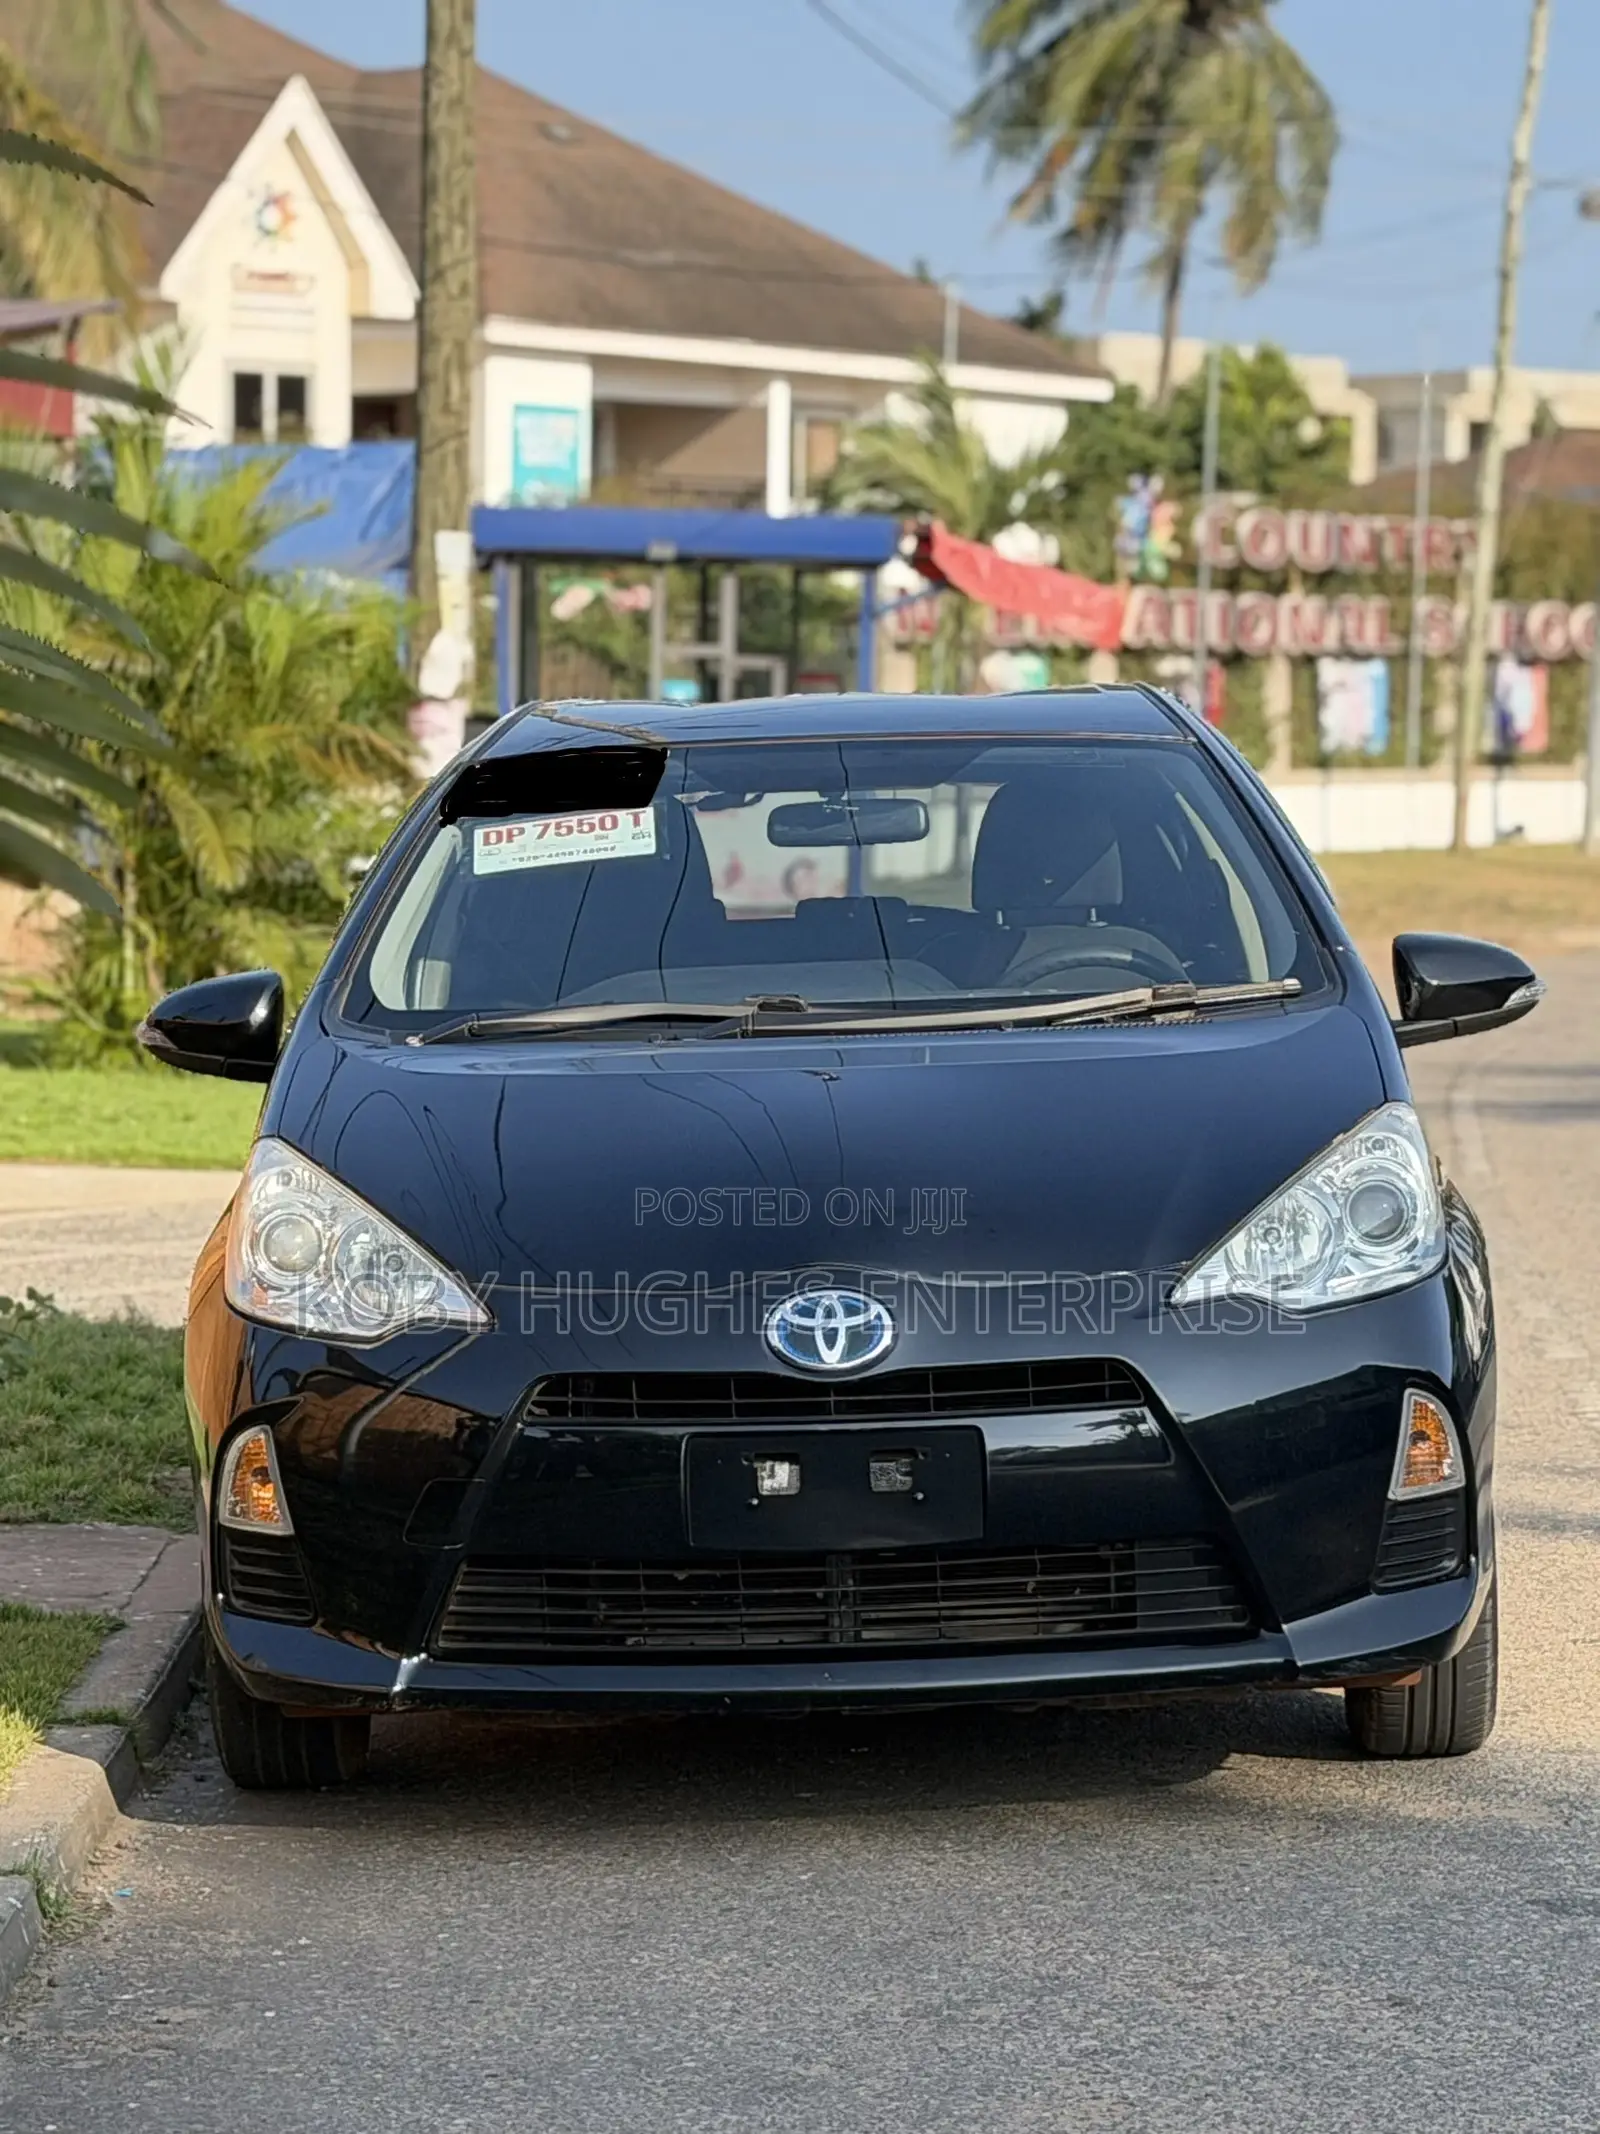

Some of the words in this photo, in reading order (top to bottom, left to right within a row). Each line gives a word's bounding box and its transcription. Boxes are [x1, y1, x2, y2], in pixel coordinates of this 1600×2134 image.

[482, 826, 526, 847] DP
[532, 814, 619, 841] 7550
[626, 810, 647, 829] T
